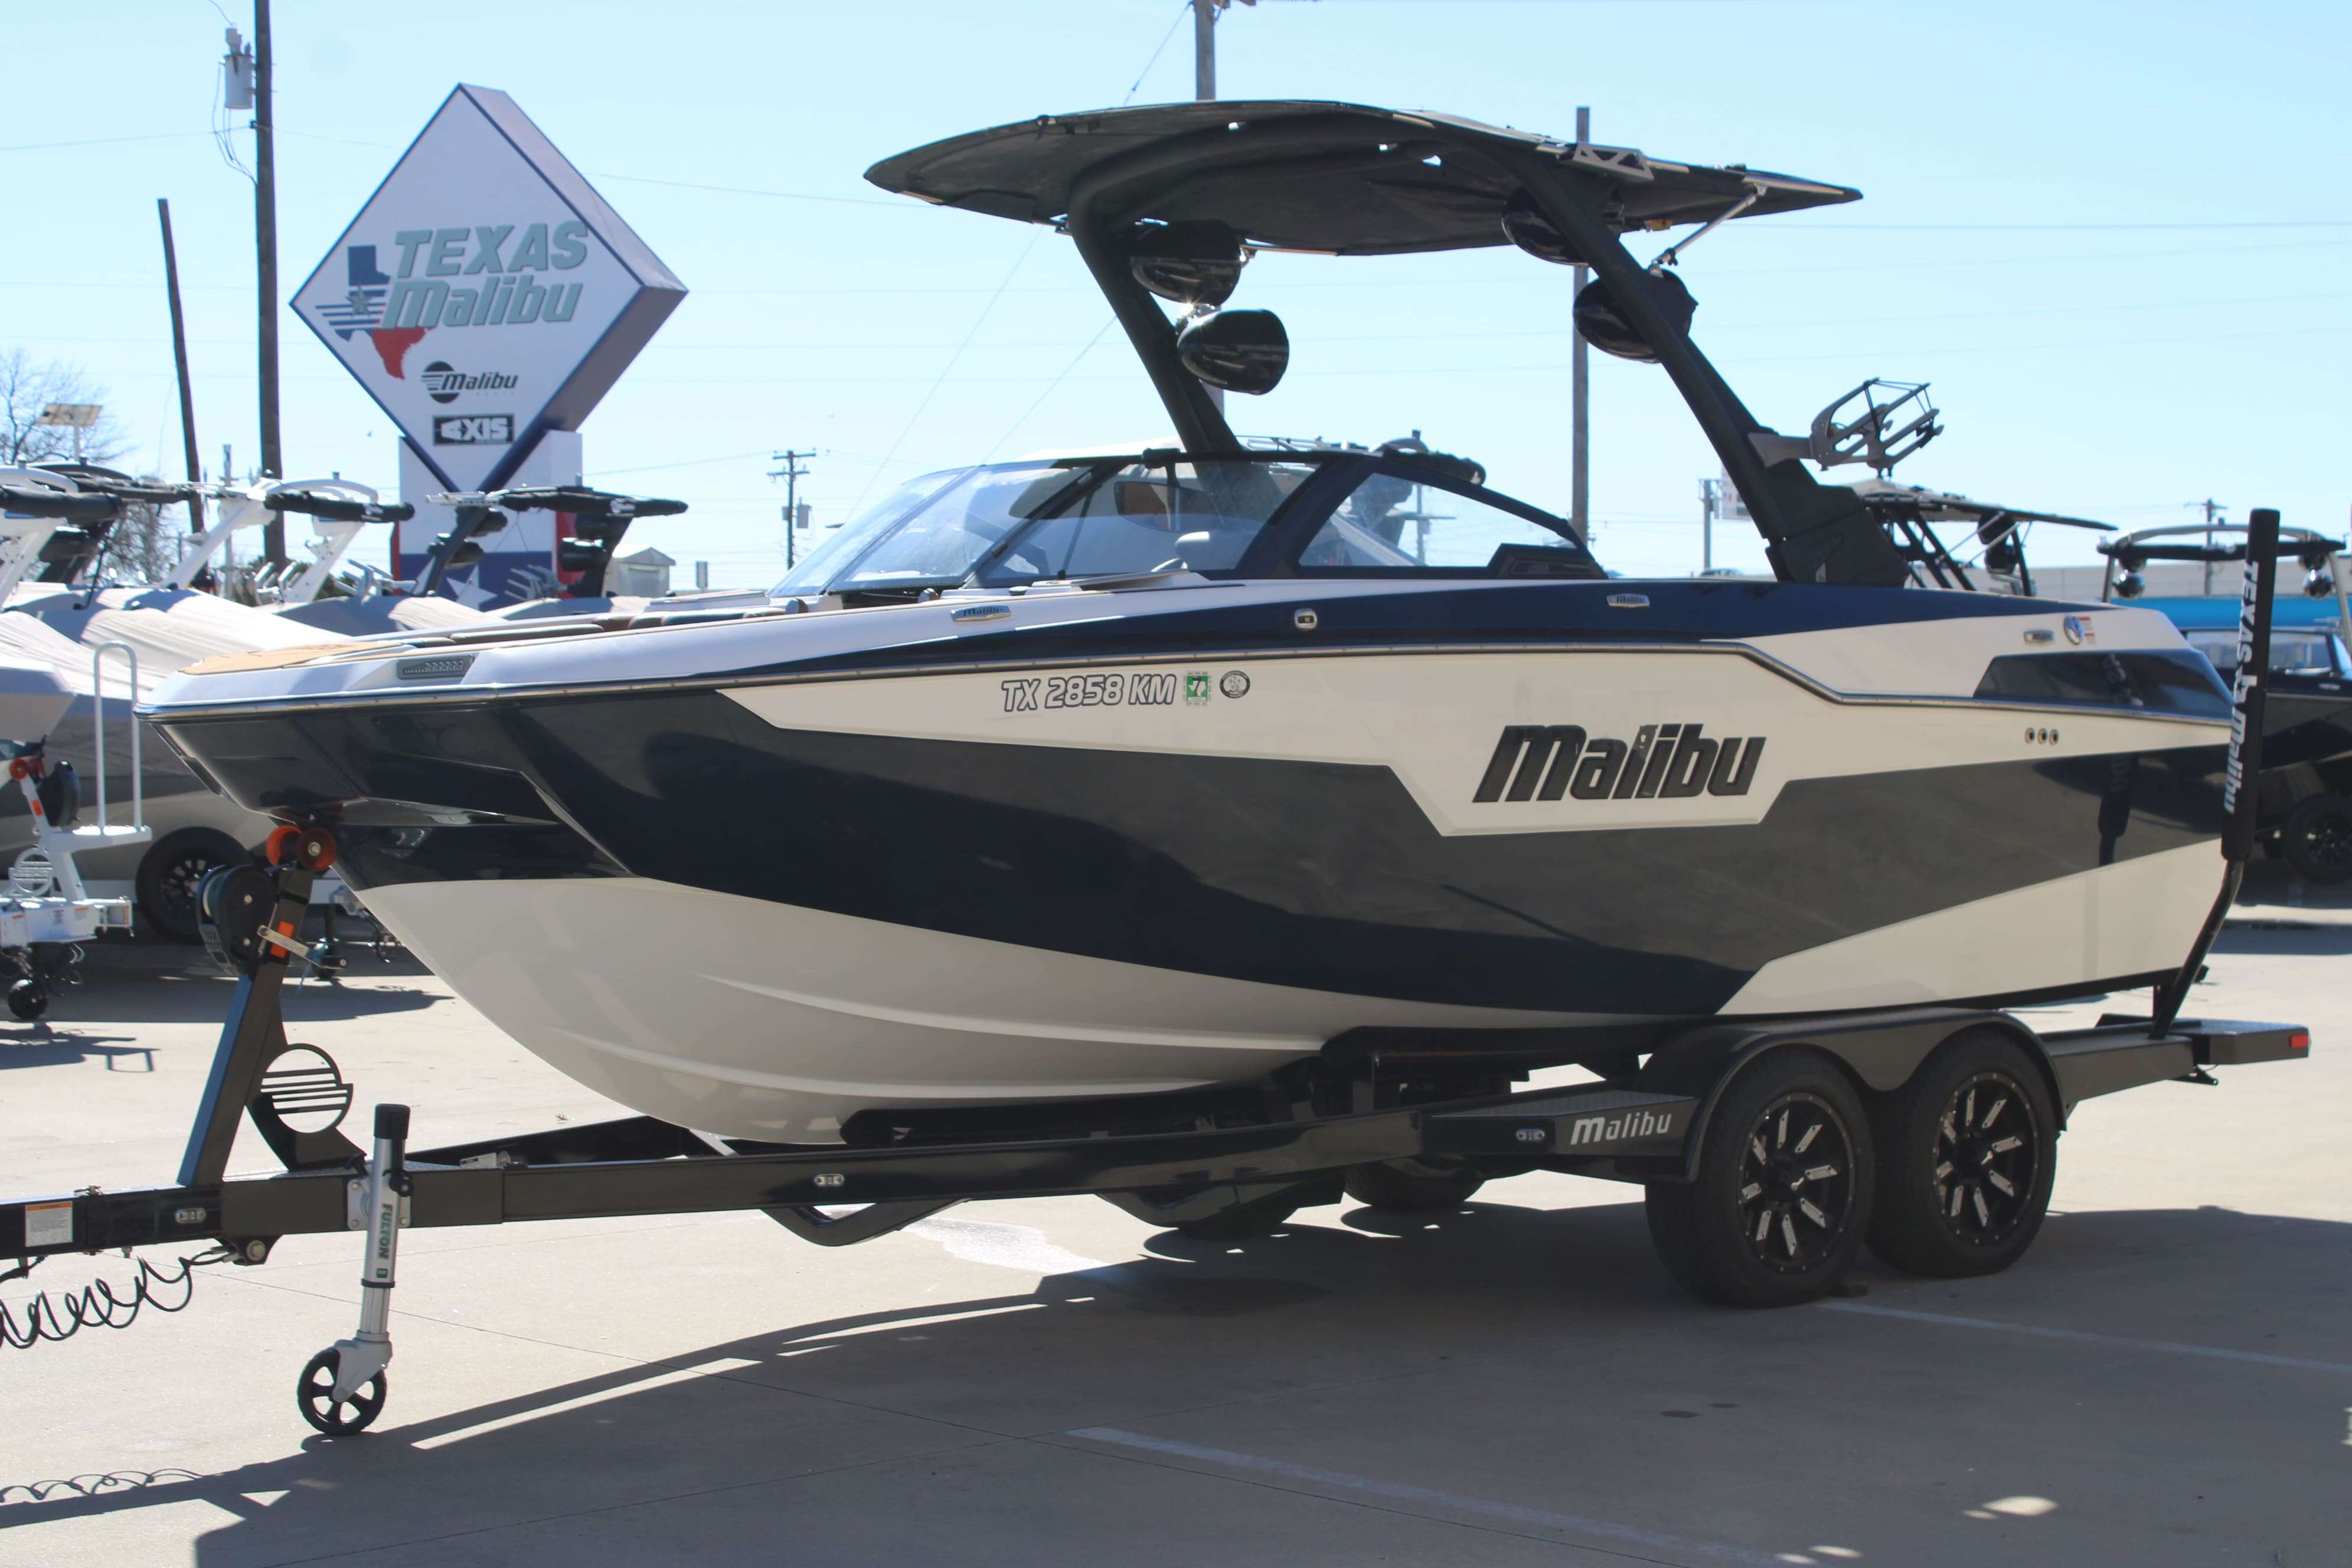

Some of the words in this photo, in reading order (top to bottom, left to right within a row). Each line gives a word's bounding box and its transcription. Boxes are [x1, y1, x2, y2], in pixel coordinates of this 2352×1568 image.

[394, 220, 588, 278] TEXAS
[379, 274, 583, 330] Malibu
[441, 371, 518, 391] Malibu
[440, 417, 508, 440] AXIS
[2237, 560, 2259, 664] TEXAS
[1001, 678, 1041, 712] TX
[1044, 673, 1124, 709] 2858
[1128, 673, 1177, 705] KM
[1472, 723, 1767, 803] Malibu
[2224, 705, 2247, 813] Malibu
[1570, 1111, 1672, 1145] Malibu
